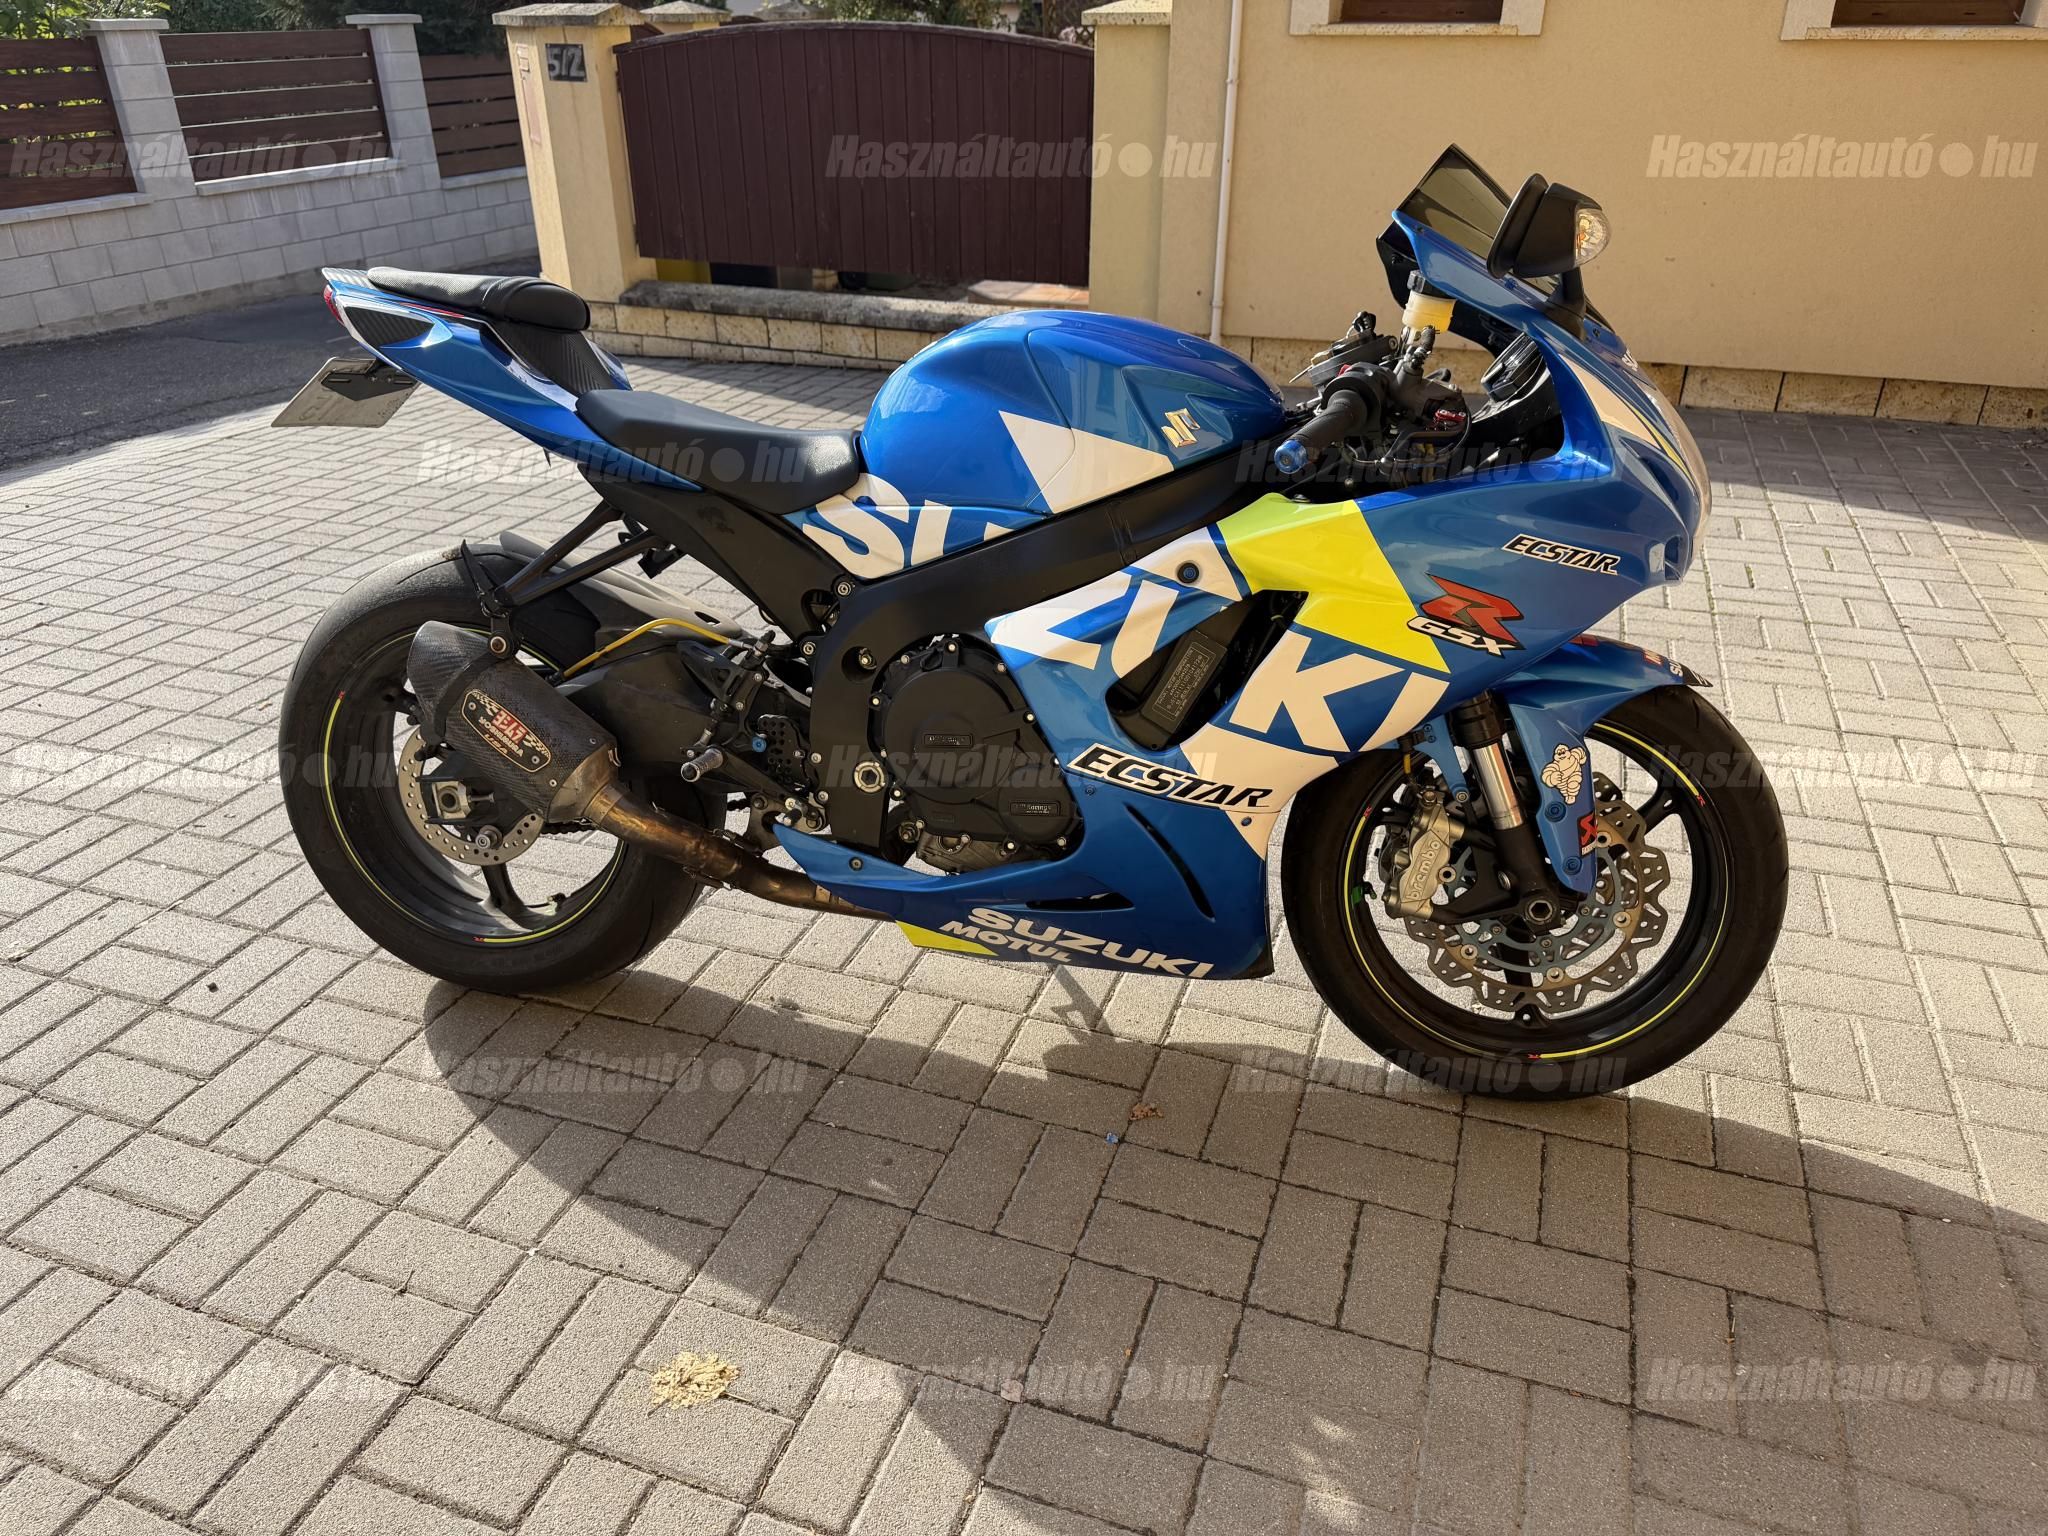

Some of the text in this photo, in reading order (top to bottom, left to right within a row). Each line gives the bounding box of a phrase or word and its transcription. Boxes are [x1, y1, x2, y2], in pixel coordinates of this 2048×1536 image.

[1502, 534, 1621, 575] ECSTAR
[1407, 616, 1517, 656] GSX
[1070, 744, 1276, 810] ECSTAR
[1405, 840, 1441, 900] brembo
[939, 920, 1072, 963] MOTUL
[967, 907, 1214, 977] SUZUKI
